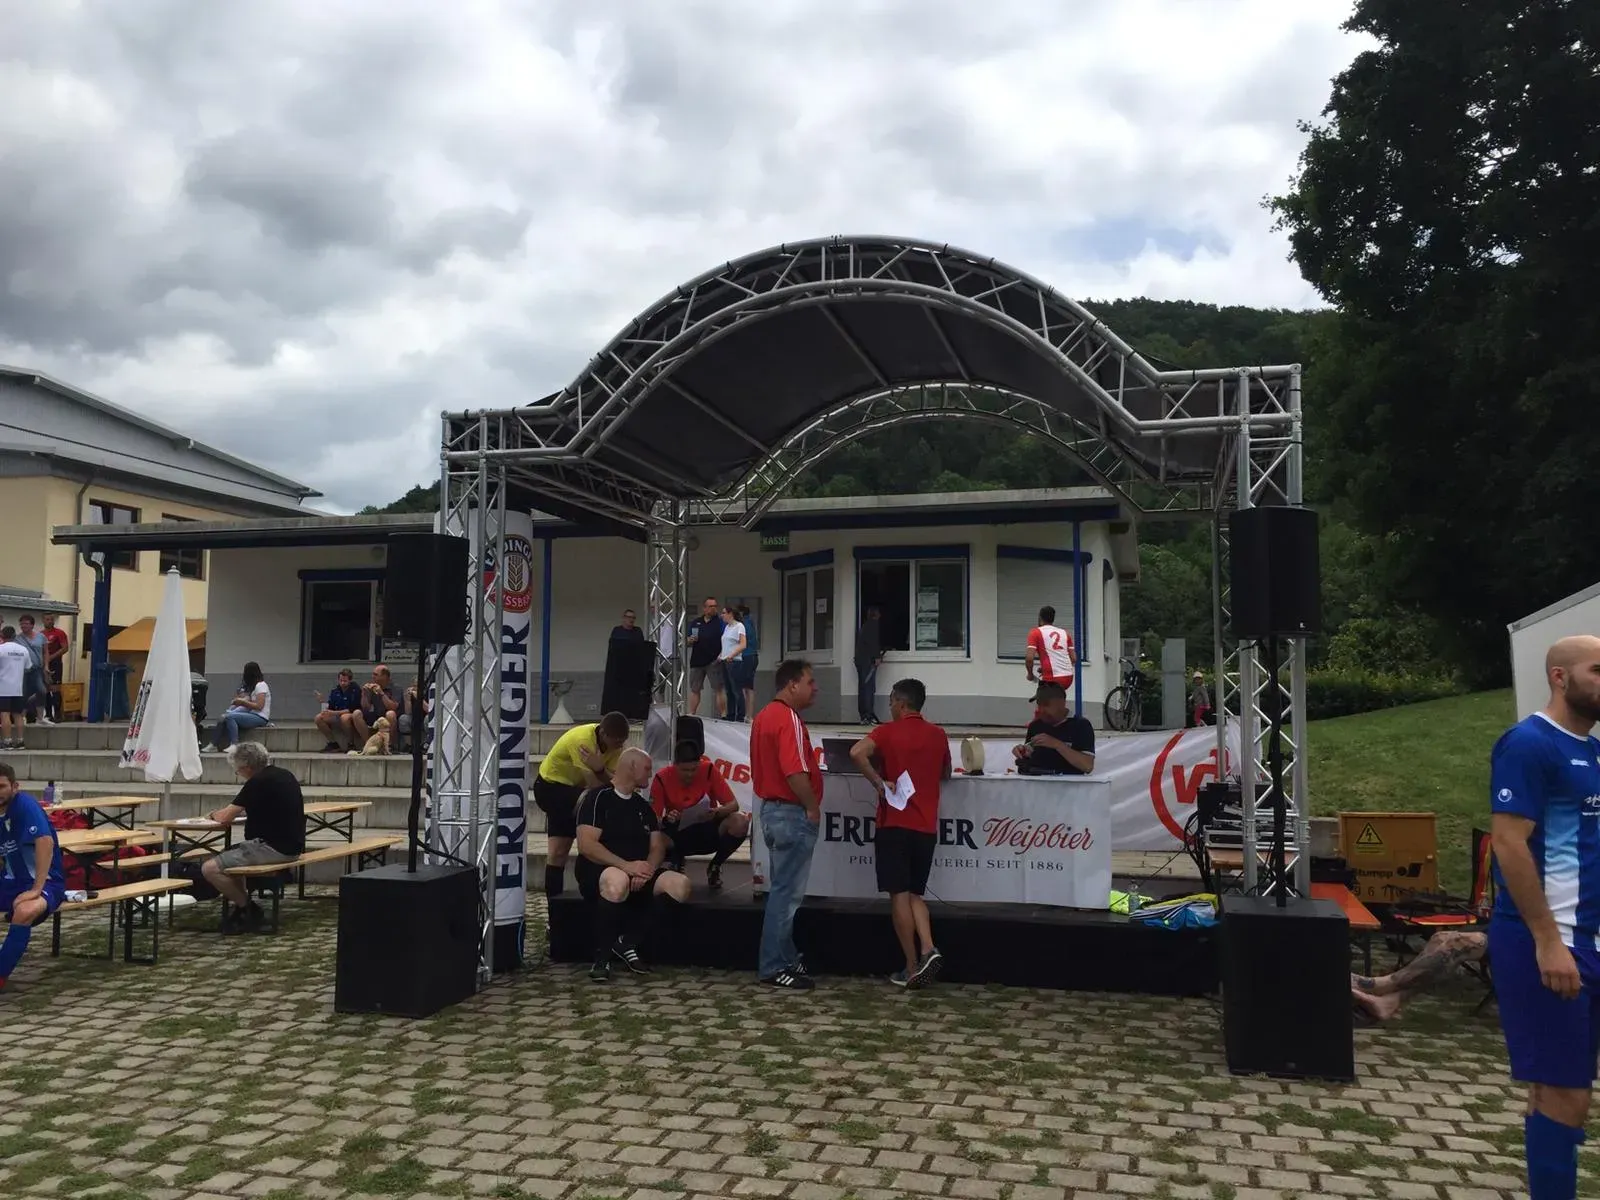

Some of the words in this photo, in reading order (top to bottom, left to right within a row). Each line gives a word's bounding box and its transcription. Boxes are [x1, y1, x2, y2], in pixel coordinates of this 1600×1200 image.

[762, 535, 788, 546] KASSE
[1049, 631, 1064, 651] 2
[495, 620, 530, 889] ERDINGER
[824, 812, 979, 849] ERDER
[982, 816, 1094, 855] Weißbier
[849, 855, 980, 868] PRIUEREI
[986, 859, 1021, 869] SEIT
[1029, 861, 1064, 871] 1886
